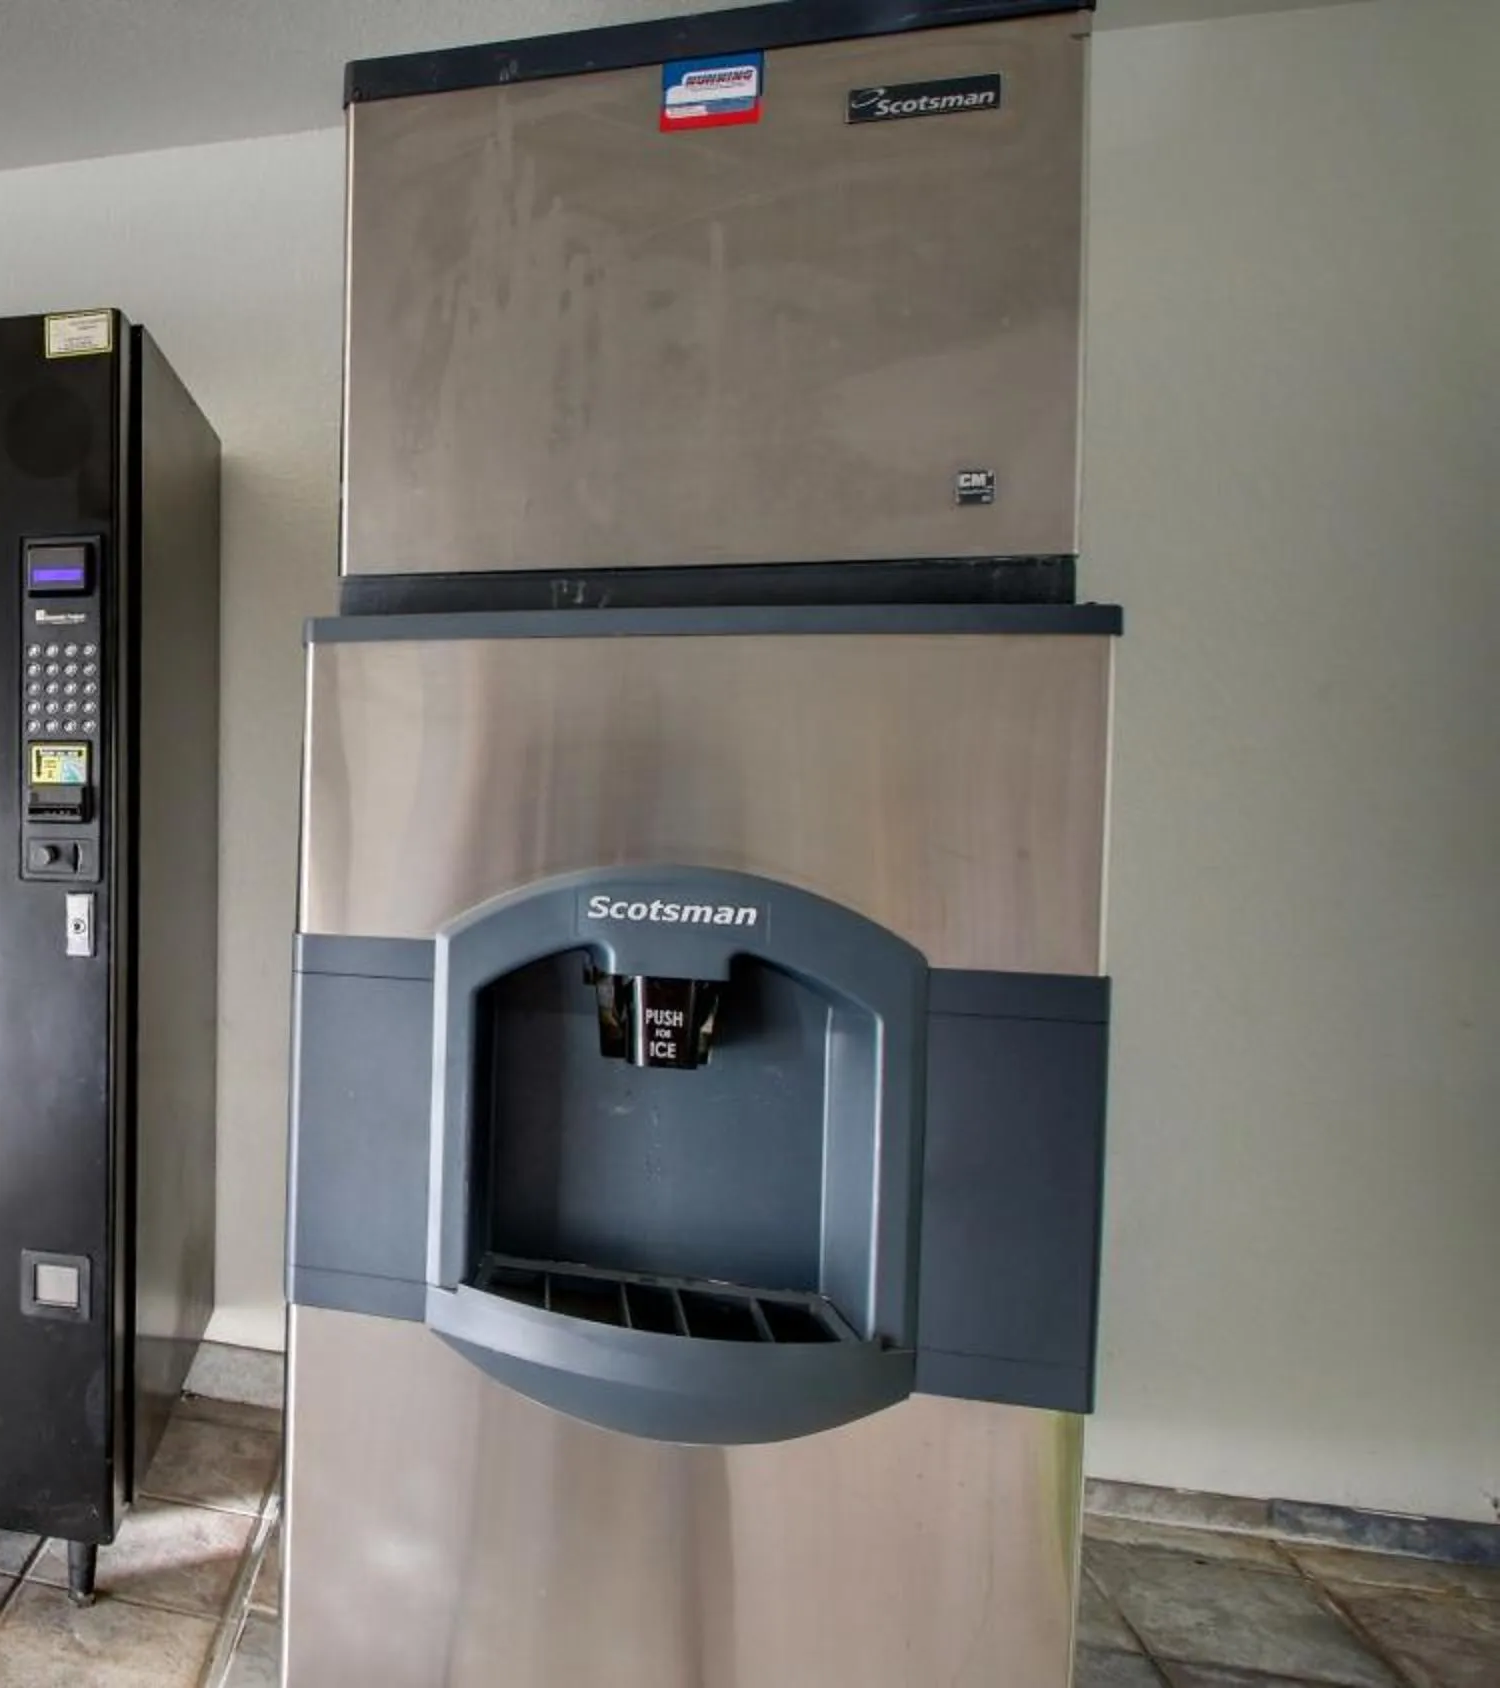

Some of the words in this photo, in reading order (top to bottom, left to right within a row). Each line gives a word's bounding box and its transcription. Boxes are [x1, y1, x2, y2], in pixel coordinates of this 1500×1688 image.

[874, 90, 995, 117] Scotsman
[587, 895, 758, 927] Scotsman
[645, 1009, 684, 1029] PUSH
[655, 1028, 672, 1038] FOR
[649, 1041, 677, 1059] ICE
